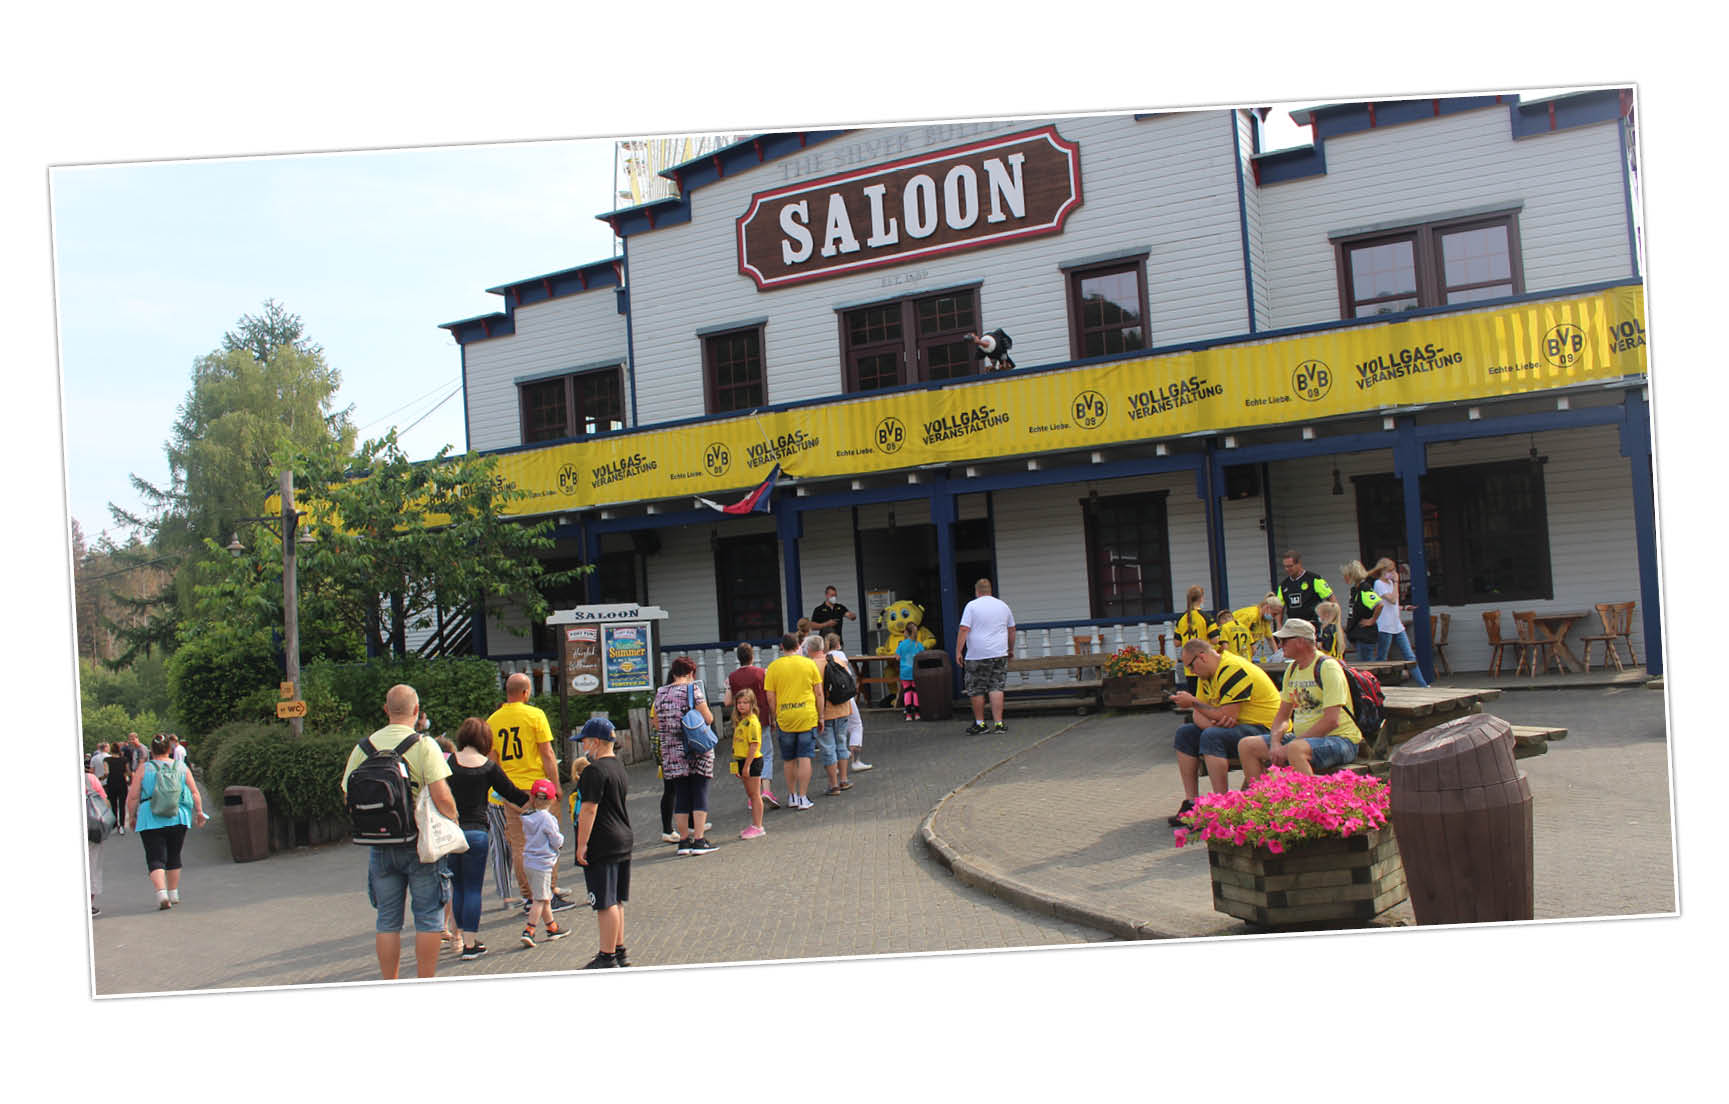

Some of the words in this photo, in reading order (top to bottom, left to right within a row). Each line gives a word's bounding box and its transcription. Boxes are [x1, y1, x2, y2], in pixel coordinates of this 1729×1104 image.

[779, 152, 1026, 266] SALOON
[1547, 327, 1584, 358] BVB
[1356, 343, 1445, 378] VOLLGAS-
[1356, 352, 1464, 391] VERANSTALTUNG
[1488, 365, 1514, 375] Echte
[1559, 353, 1574, 365] 09
[1296, 362, 1330, 391] BVB
[1127, 383, 1225, 421] VERANSTALTUNG
[1128, 376, 1208, 409] VOLLGAS-
[1244, 397, 1267, 408] Echte
[1307, 388, 1320, 398] 09
[923, 404, 996, 435] VOLLGAS-
[1075, 393, 1105, 420] BVB
[878, 421, 904, 445] BVB
[922, 412, 1010, 446] VERANSTALTUNG
[1028, 424, 1049, 433] Echte
[706, 445, 729, 468] BVB
[746, 430, 809, 459] VOLLGAS-
[746, 437, 820, 469] VERANSTALTUNG
[836, 449, 855, 457] Echte
[559, 466, 578, 487] BVB
[591, 460, 657, 488] VERANSTALTUNG
[592, 454, 647, 481] VOLLGAS-
[576, 609, 639, 620] SALOON
[609, 648, 646, 658] Summer
[497, 726, 524, 761] 23
